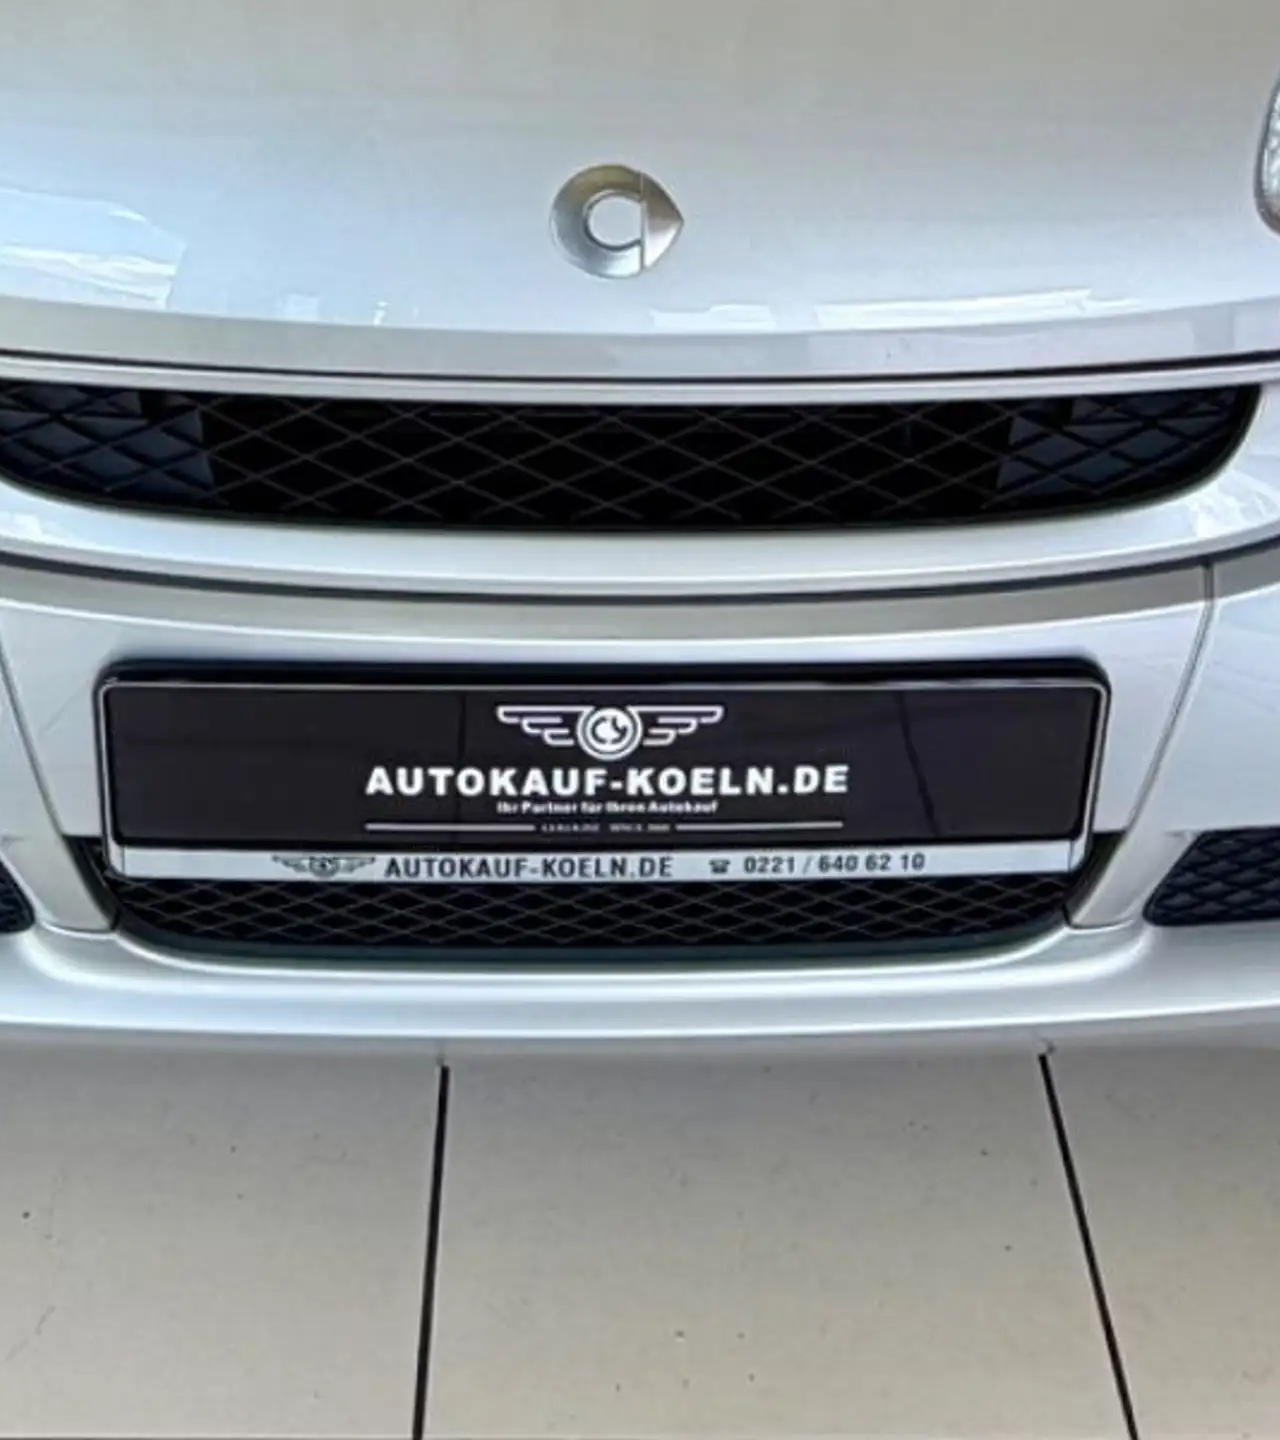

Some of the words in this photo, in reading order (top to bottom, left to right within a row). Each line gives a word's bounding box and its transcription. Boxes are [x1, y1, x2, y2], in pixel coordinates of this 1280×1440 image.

[365, 764, 850, 797] AUTOKAUF-KOELN.DE
[384, 855, 673, 879] AUTOKAUF-KOELN.DE
[744, 856, 796, 874] 0221
[818, 854, 859, 873] 640
[865, 853, 892, 872] 62
[900, 852, 926, 872] 10
